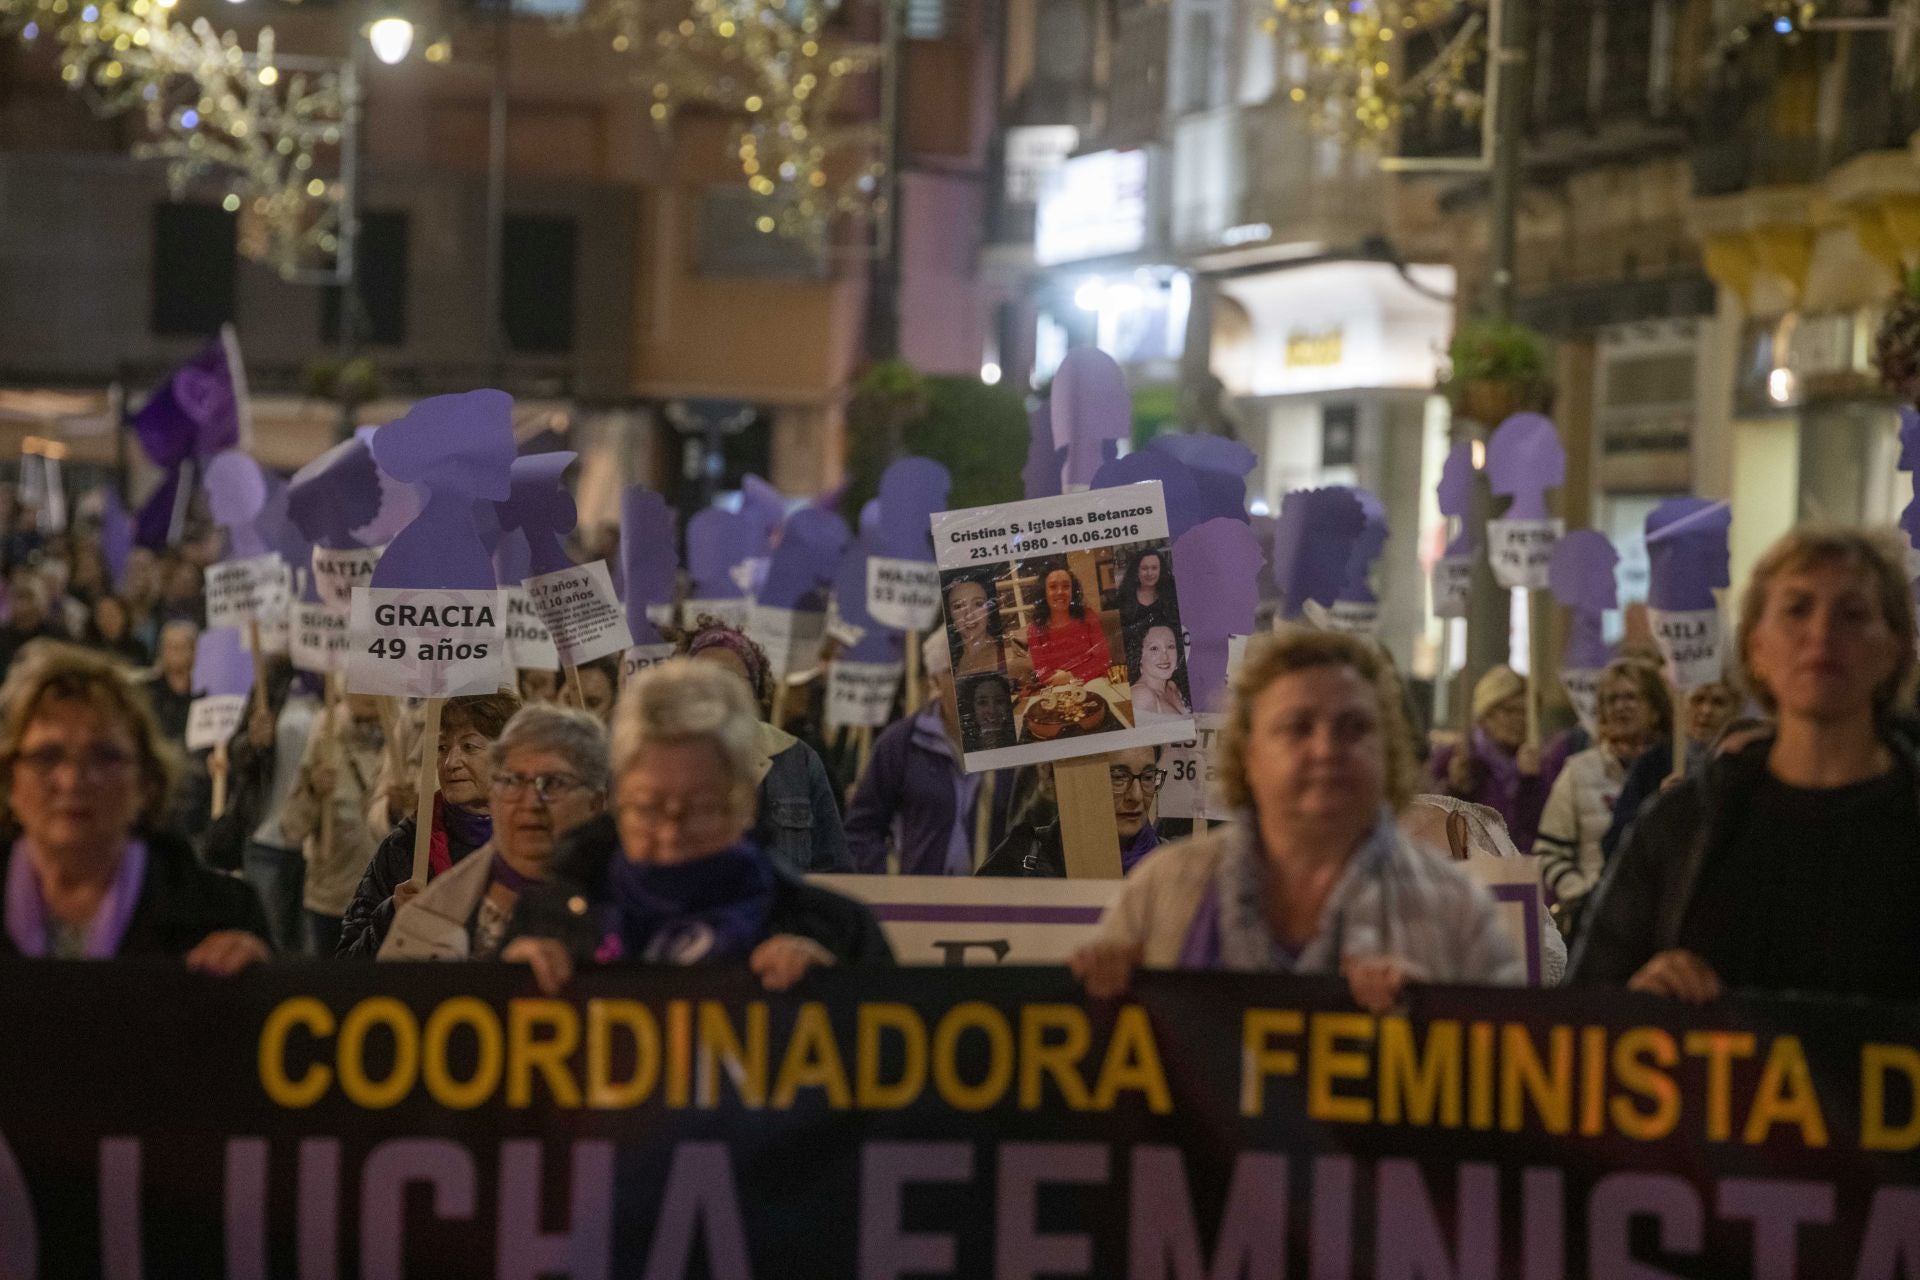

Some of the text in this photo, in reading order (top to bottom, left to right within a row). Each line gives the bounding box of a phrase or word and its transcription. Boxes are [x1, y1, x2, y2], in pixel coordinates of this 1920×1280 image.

[951, 505, 1153, 543] Cristina S. Iglesias Betanzos
[970, 538, 1048, 559] 23.11.1980
[1062, 524, 1139, 546] 10.06.2016
[552, 579, 579, 593] años
[549, 596, 562, 608] 10
[565, 590, 595, 604] años
[375, 604, 495, 627] GRACIA
[368, 637, 488, 661] 49 años
[1173, 759, 1197, 781] 36
[258, 997, 1173, 1116] COORDINADORA
[1240, 1008, 1829, 1148] FEMINISTA
